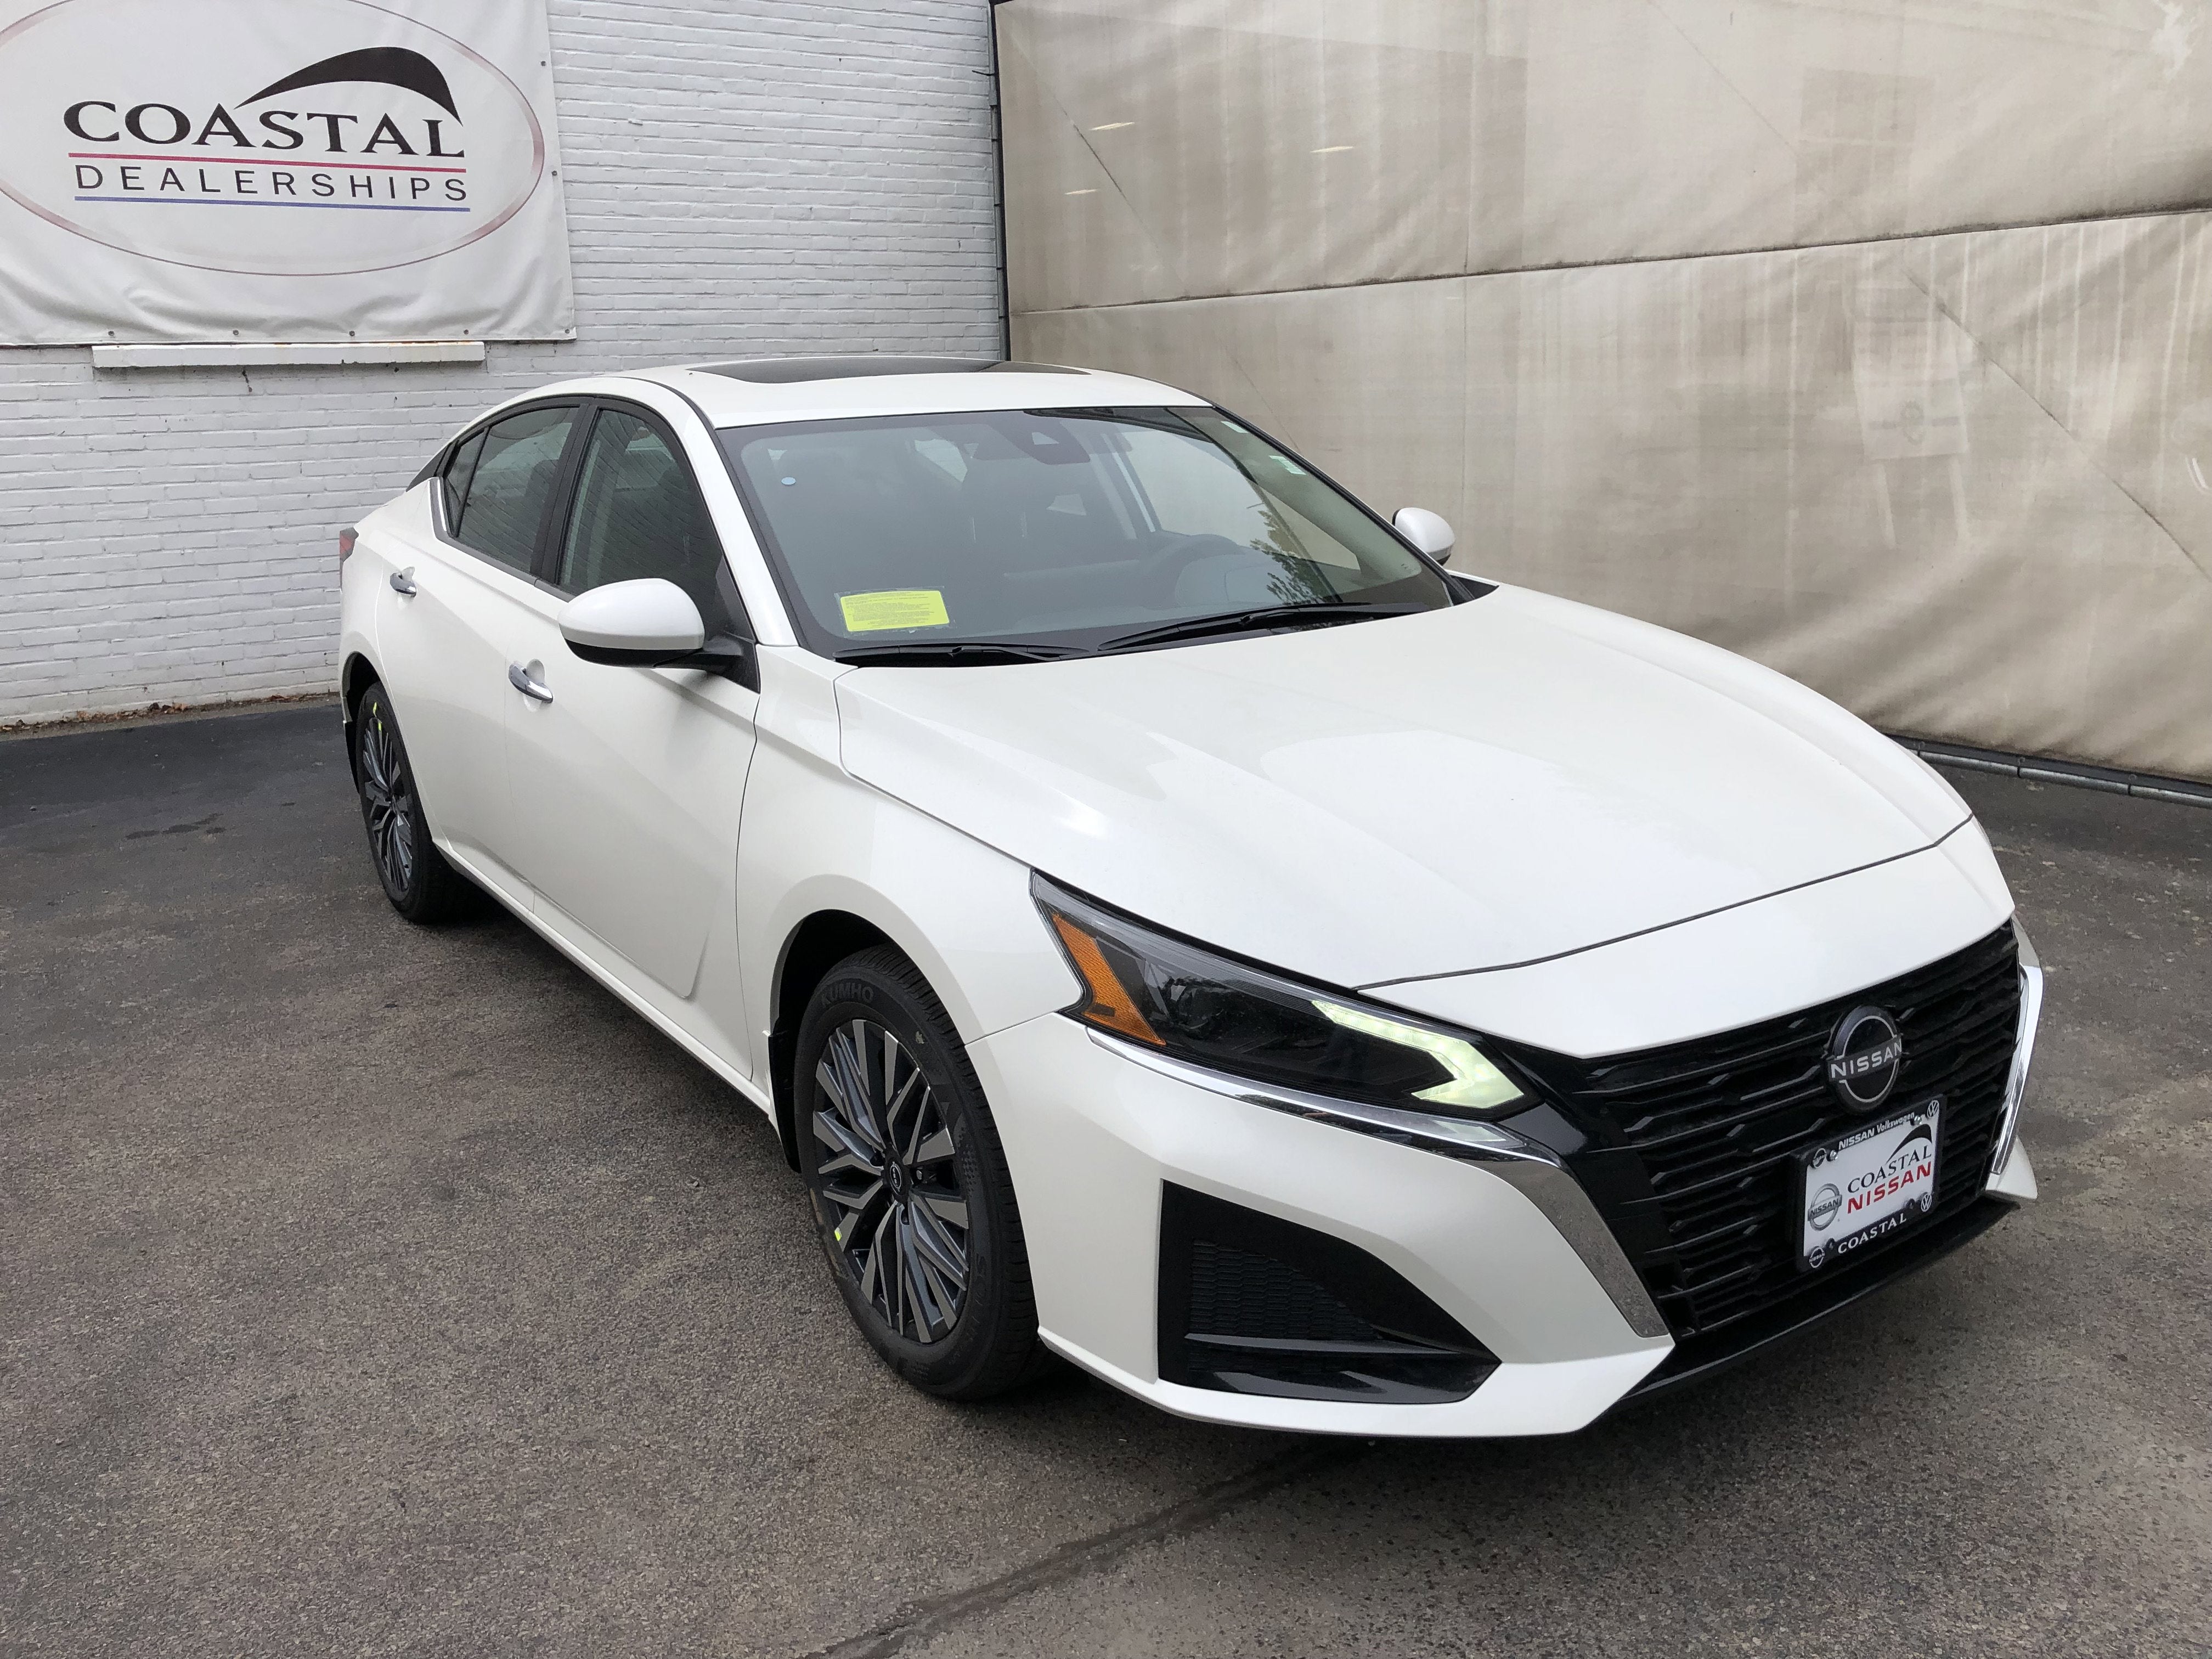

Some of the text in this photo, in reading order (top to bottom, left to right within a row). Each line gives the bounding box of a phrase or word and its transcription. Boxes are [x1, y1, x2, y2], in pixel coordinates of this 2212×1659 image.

[64, 101, 465, 158] COASTAL
[75, 164, 467, 201] DEALERSHIPS
[821, 982, 874, 1008] KUMHO
[1831, 1038, 1902, 1079] NISSAN
[1838, 1111, 1915, 1150] NISSAN Volkswagen
[1847, 1145, 1932, 1193] COASTAL
[1847, 1161, 1932, 1214] NISSAN
[1810, 1198, 1838, 1217] NISSAN
[1838, 1212, 1907, 1254] COASTAL
